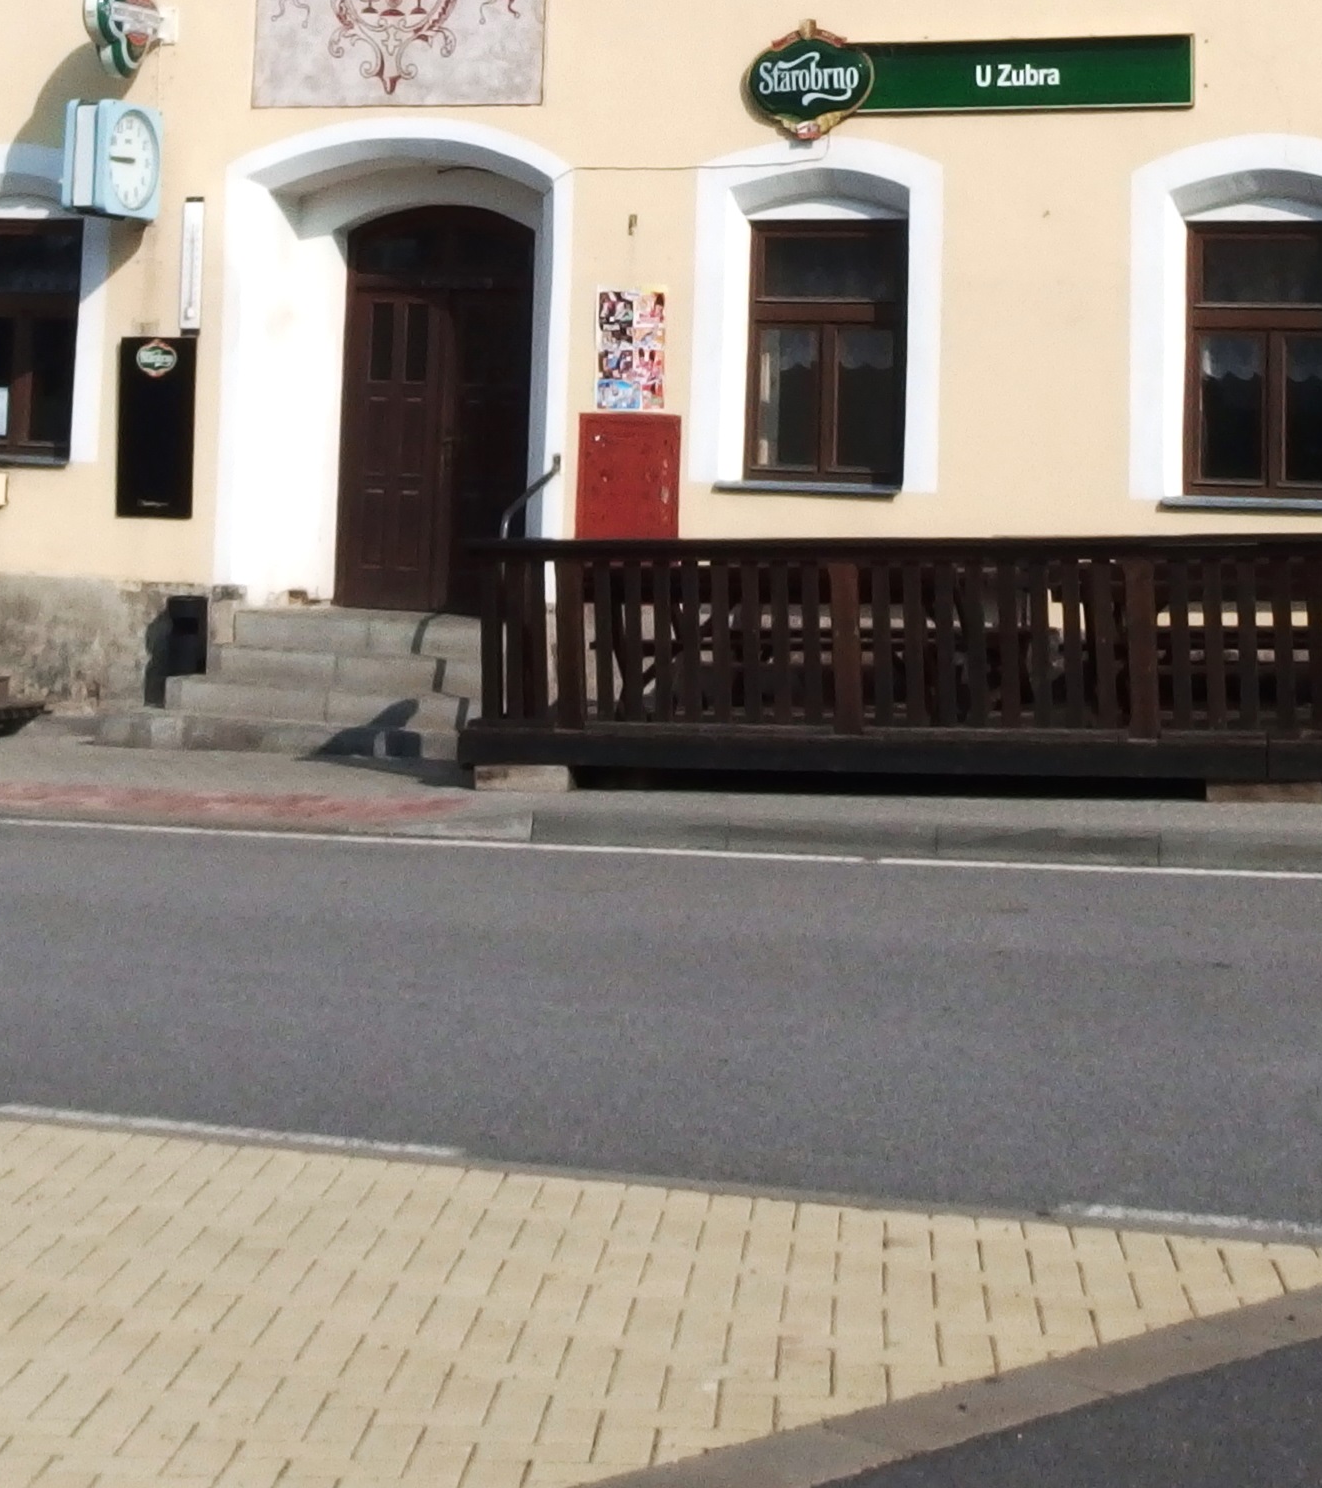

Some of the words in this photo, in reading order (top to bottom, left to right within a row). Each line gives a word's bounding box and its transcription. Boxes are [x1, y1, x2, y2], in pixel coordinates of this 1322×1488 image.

[759, 51, 859, 106] Starobrno
[975, 64, 992, 87] U
[996, 63, 1060, 86] Zubra
